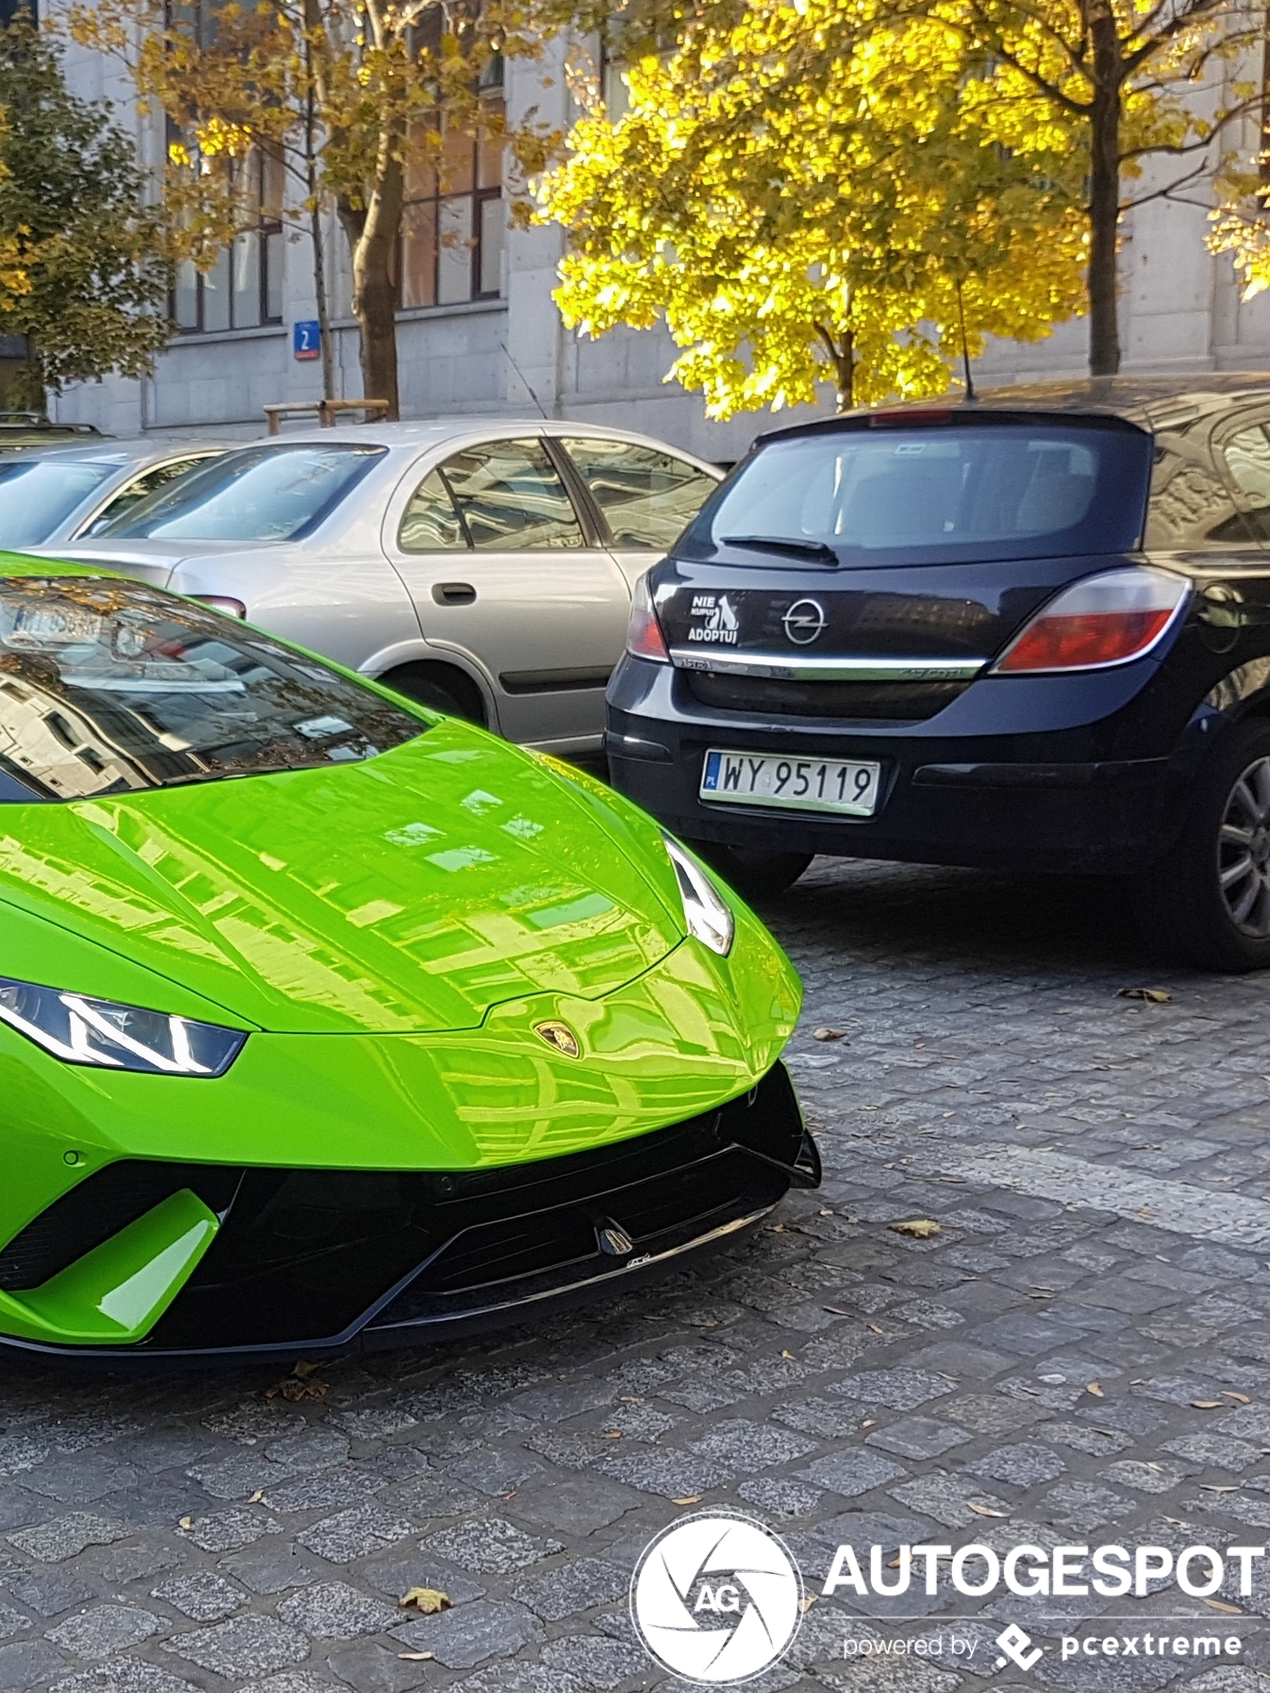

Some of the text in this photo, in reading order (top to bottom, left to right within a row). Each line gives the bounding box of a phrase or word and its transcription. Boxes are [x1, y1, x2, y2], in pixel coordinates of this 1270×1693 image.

[300, 330, 310, 350] 2
[692, 596, 716, 607] NIE
[688, 628, 738, 644] ADOPTUJ
[706, 776, 716, 786] PL
[723, 757, 872, 801] WY 95119
